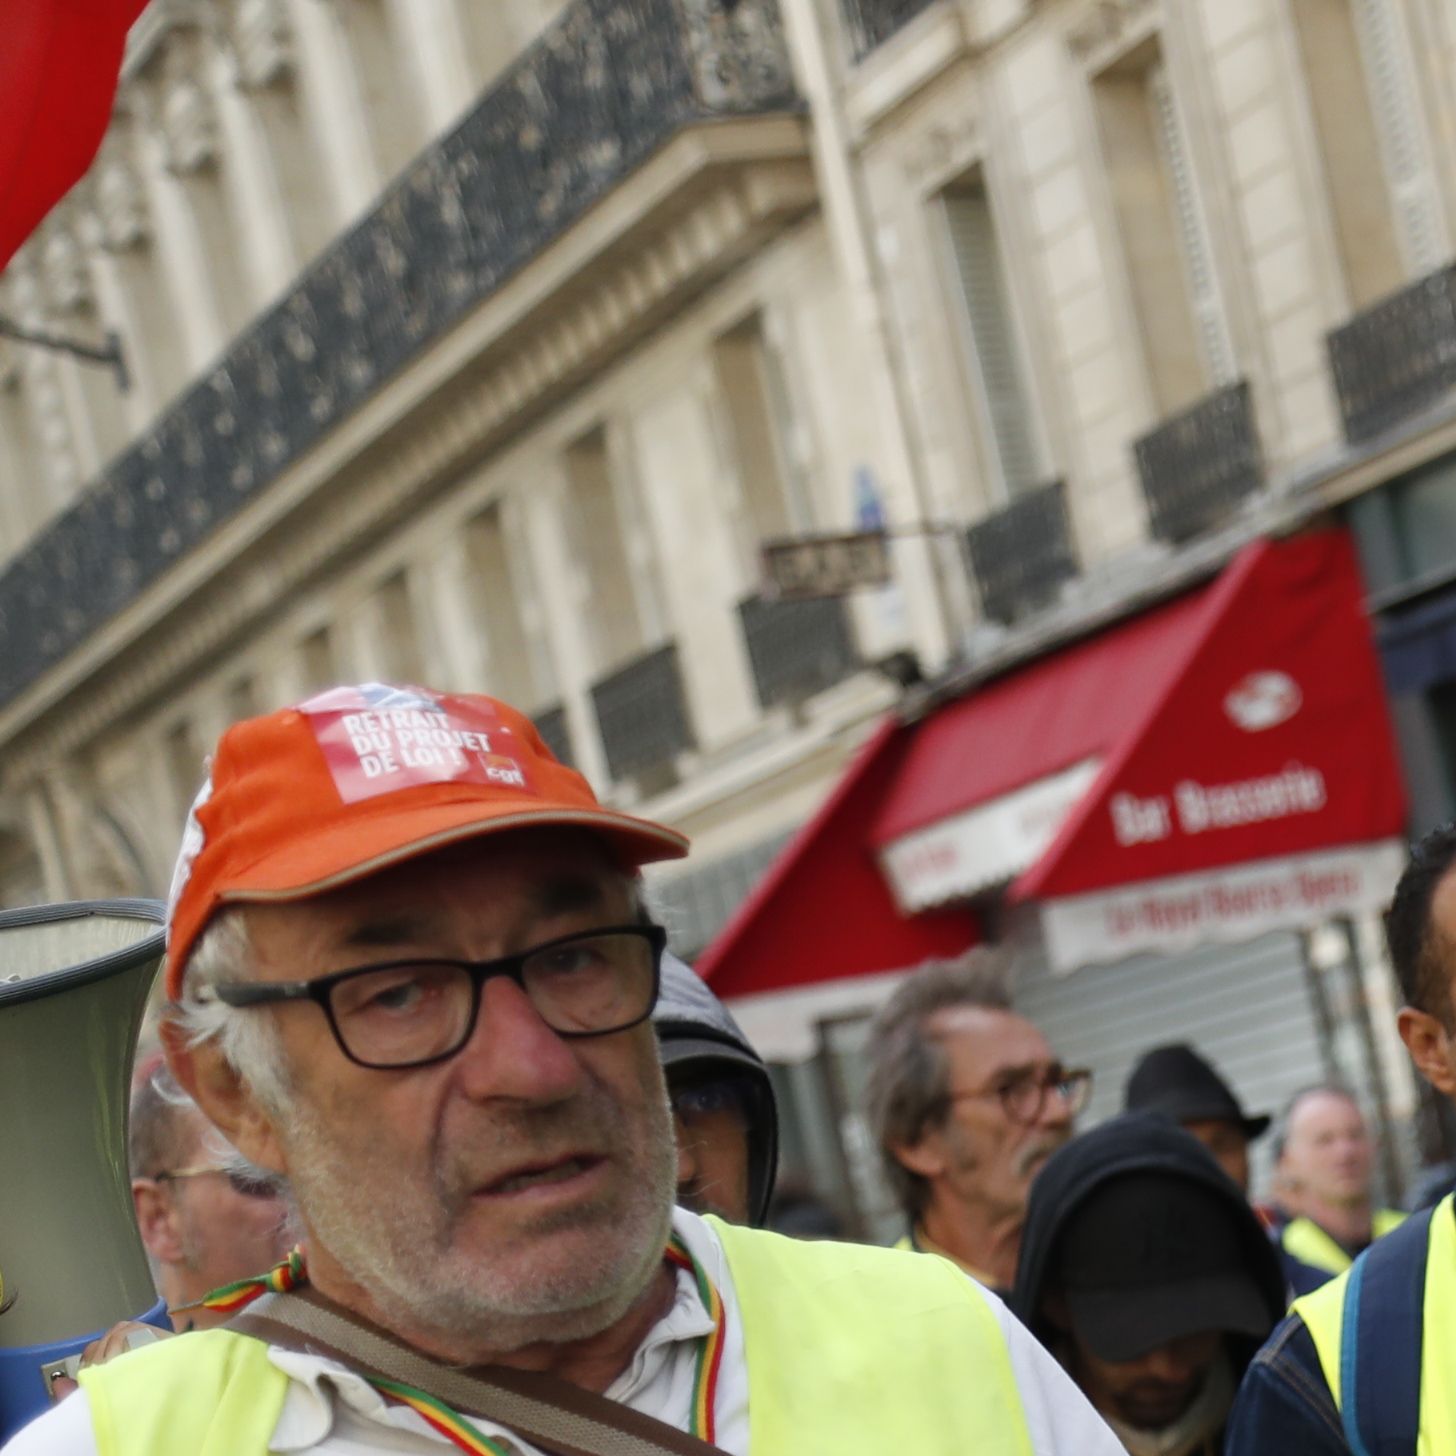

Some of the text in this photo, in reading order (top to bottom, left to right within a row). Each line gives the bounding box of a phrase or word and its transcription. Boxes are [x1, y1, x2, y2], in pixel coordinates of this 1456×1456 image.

[341, 709, 450, 735] RETRAIT
[351, 727, 492, 757] DU PROJET
[359, 752, 399, 779] DE
[400, 747, 446, 769] LOI
